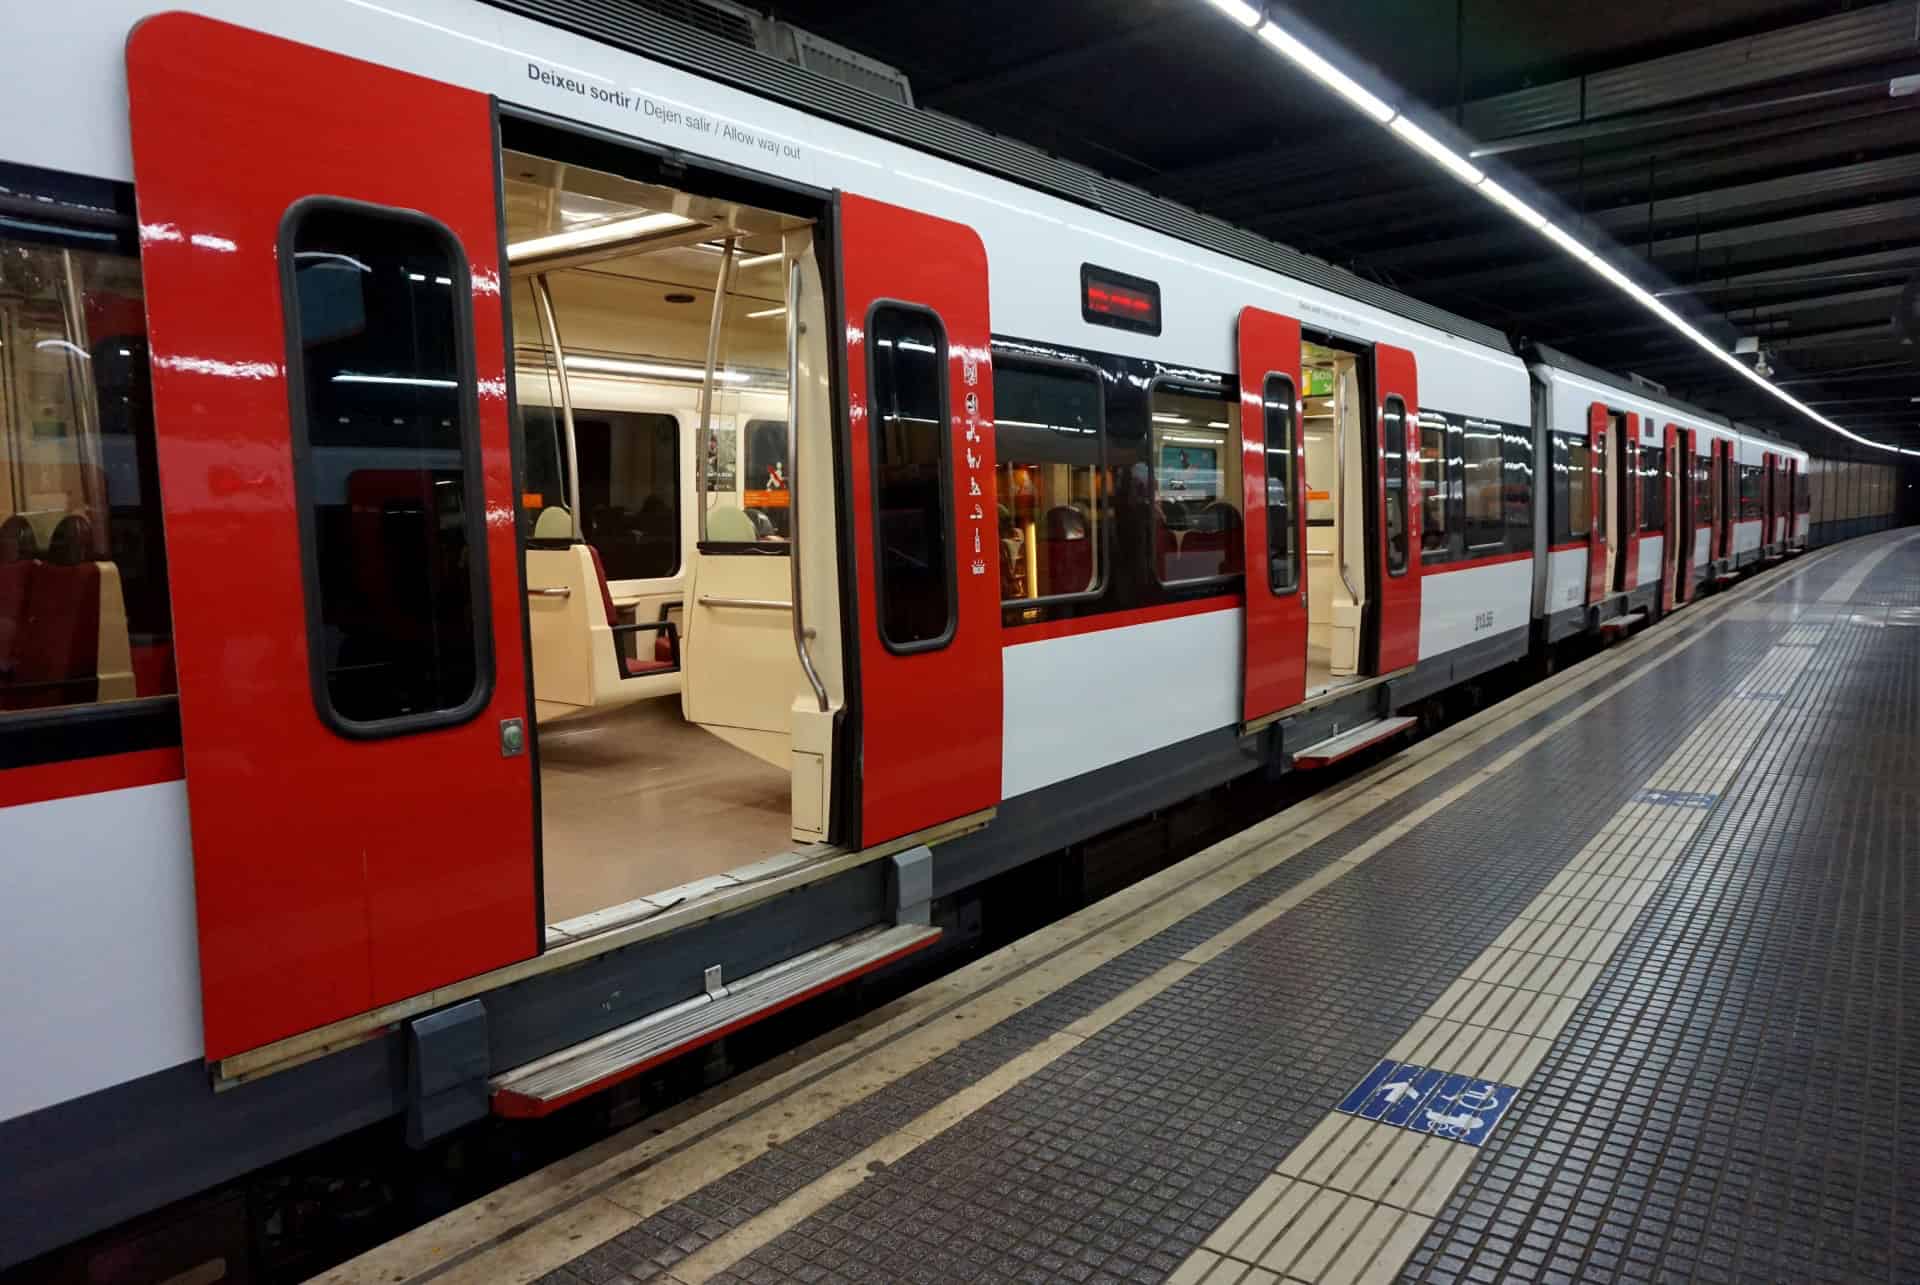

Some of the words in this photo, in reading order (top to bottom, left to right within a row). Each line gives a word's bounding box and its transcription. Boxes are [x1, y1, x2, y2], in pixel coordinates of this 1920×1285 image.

[528, 63, 585, 95] Deixeu
[590, 86, 631, 110] sortir
[644, 100, 682, 125] Dejen
[686, 115, 711, 133] salir
[723, 125, 755, 145] Allow
[758, 139, 781, 156] way
[784, 144, 801, 160] out
